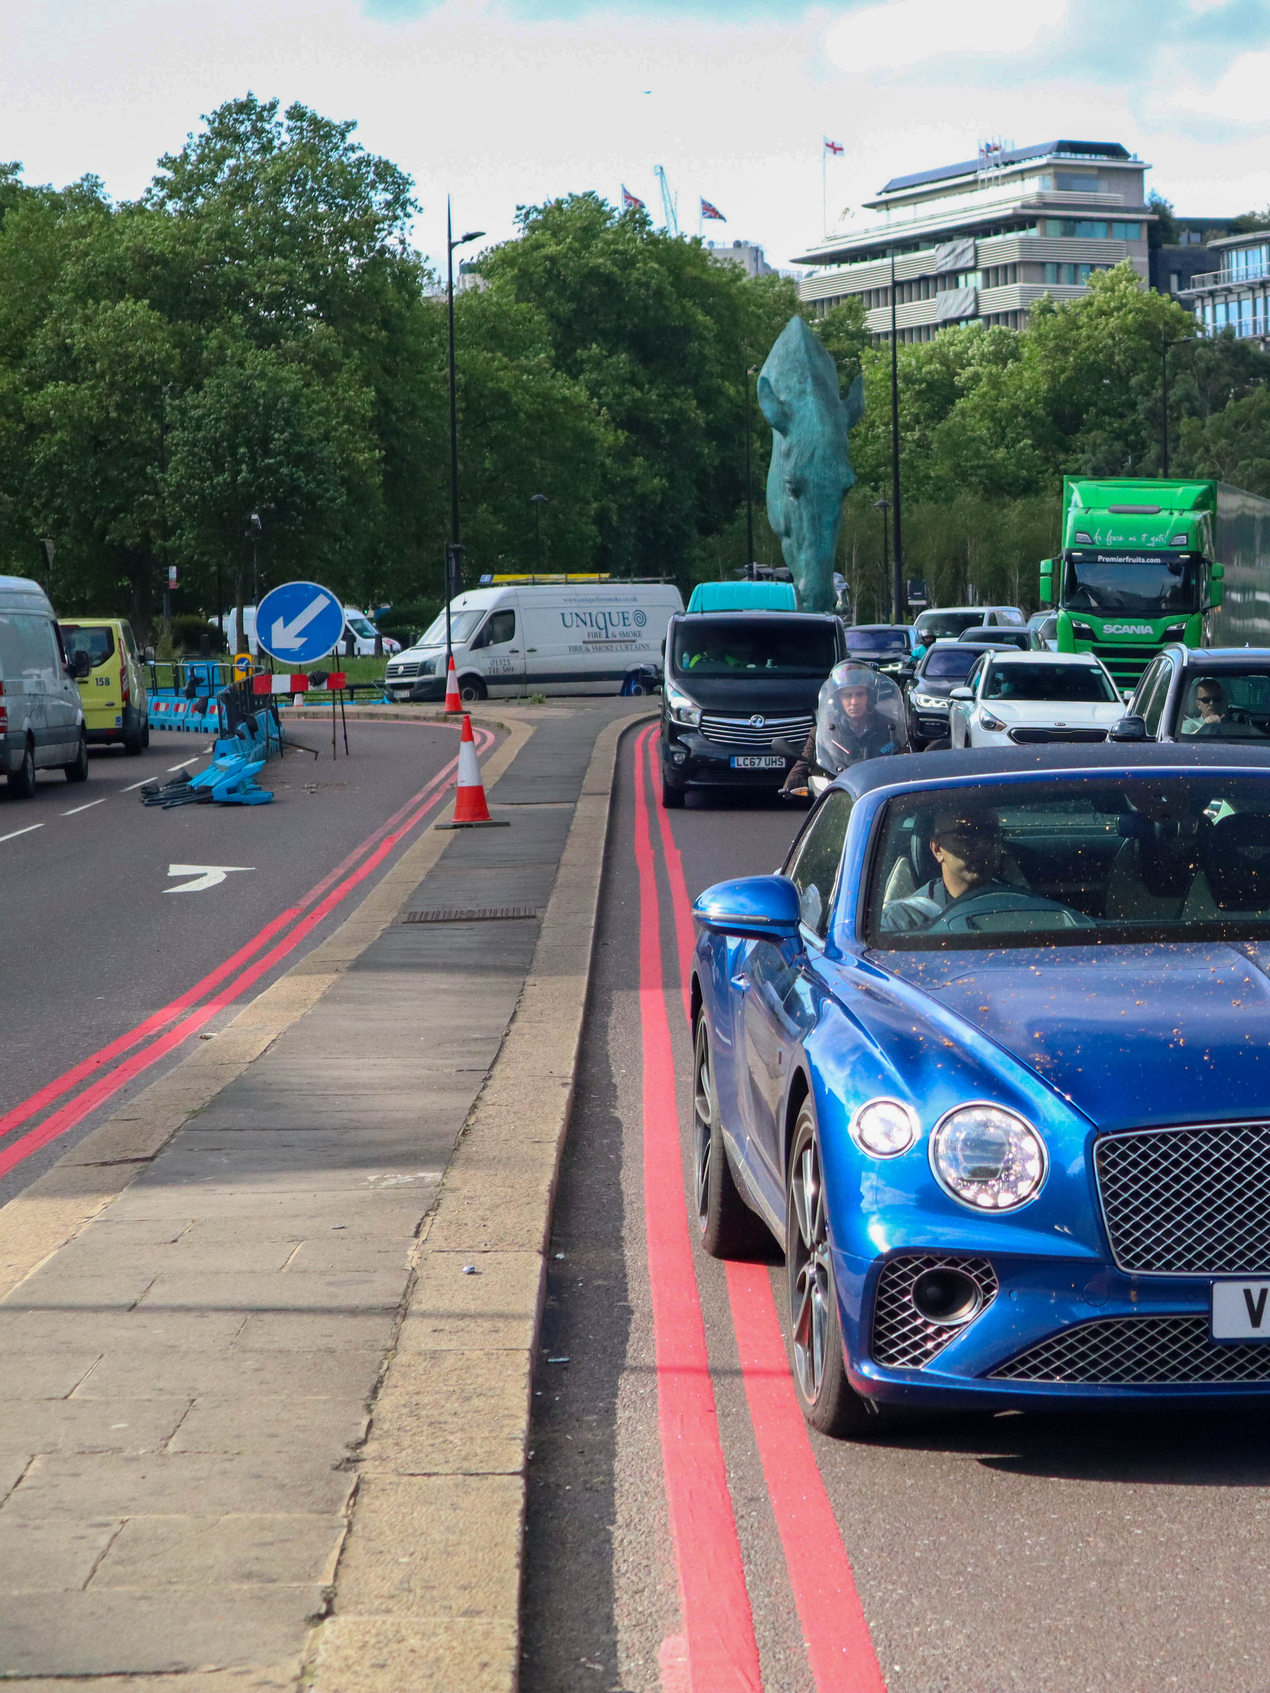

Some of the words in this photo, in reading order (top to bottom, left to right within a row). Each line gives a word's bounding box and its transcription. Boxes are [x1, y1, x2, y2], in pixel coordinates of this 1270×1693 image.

[1097, 555, 1161, 564] Premierfruits.com
[588, 631, 604, 639] FIRE
[619, 630, 643, 638] SMOKE
[1103, 624, 1154, 635] SCANIA
[569, 645, 583, 653] FIRE
[592, 644, 614, 652] SMOKE
[615, 643, 650, 652] CURTAINS
[95, 677, 111, 687] 158
[736, 757, 762, 767] LC67
[764, 757, 784, 767] UHS
